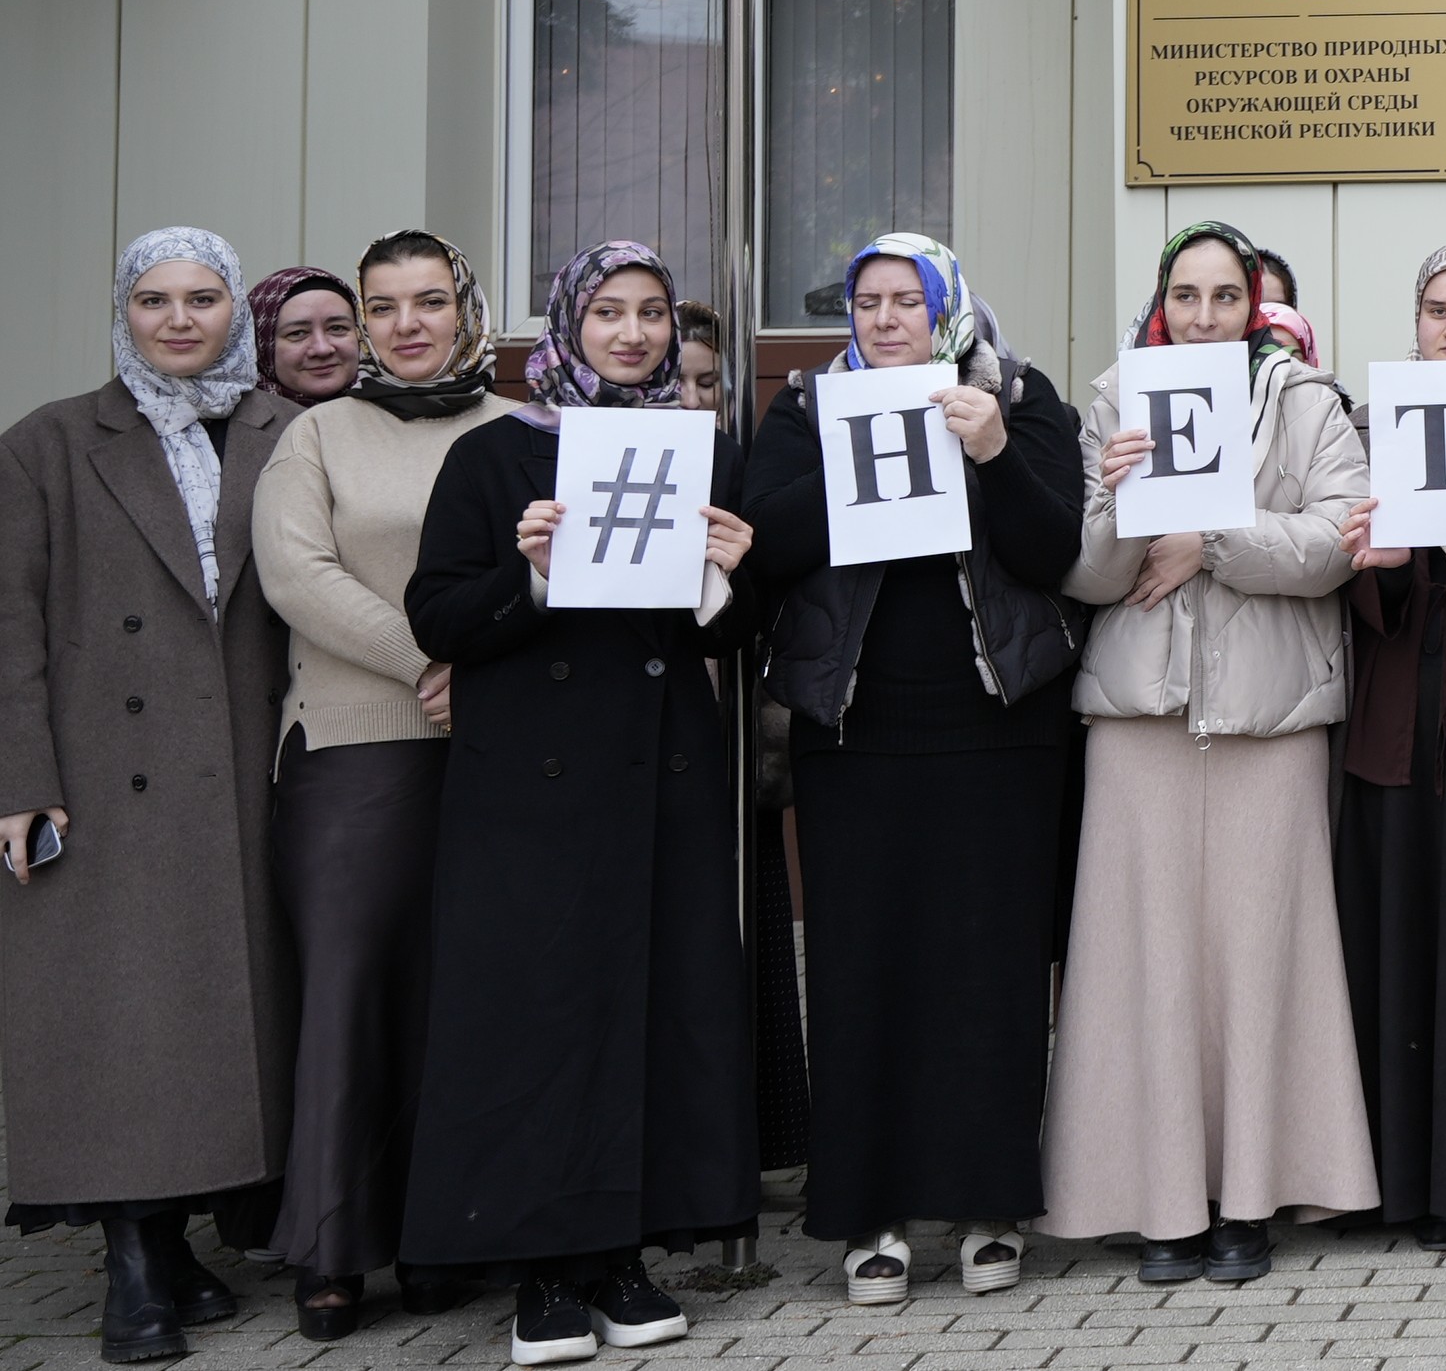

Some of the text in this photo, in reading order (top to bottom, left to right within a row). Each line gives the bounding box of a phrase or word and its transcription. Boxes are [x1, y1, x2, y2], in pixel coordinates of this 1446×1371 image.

[1151, 41, 1318, 60] МИНИСТЕРСТВО
[1195, 67, 1410, 86] РЕСУРСОВ И ОХРАНЫ
[1186, 91, 1418, 114] ОКРУЖАЮЩЕЙ СРЕДЫ
[1170, 120, 1435, 141] ЧЕЧЕНСКОЙ РЕСПУБЛИКИ
[588, 447, 678, 565] #
[836, 405, 947, 507] Н
[1137, 386, 1222, 480] Е
